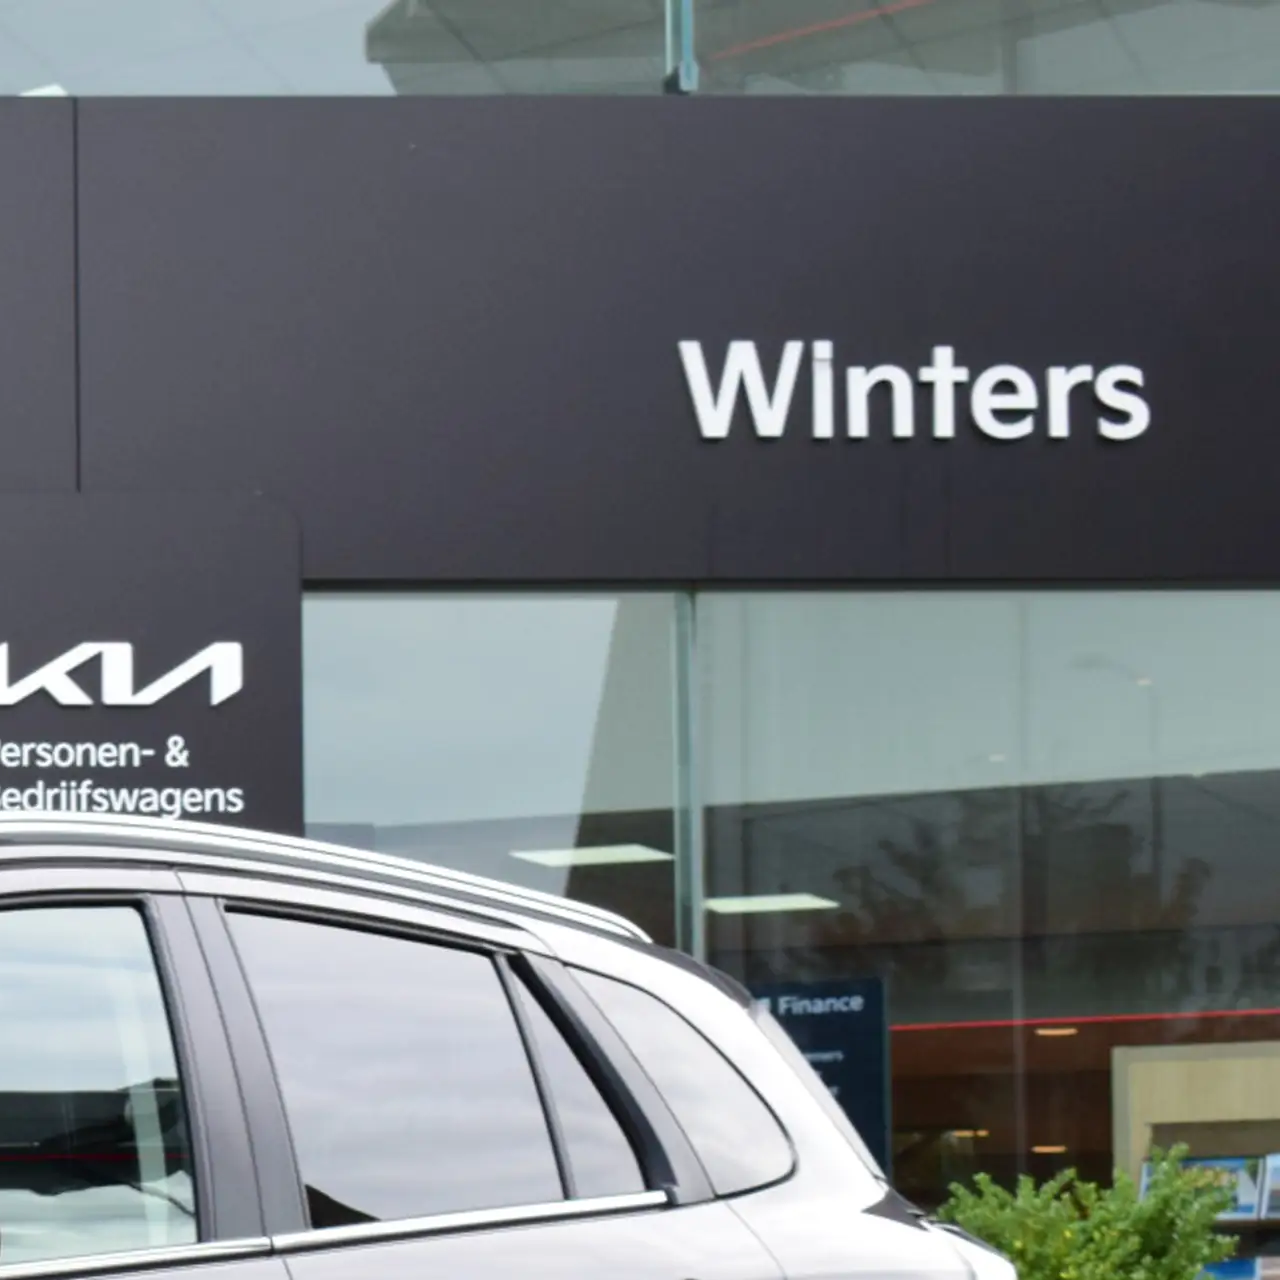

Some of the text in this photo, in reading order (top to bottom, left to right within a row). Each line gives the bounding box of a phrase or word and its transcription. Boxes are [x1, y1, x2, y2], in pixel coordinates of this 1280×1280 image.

[677, 340, 1151, 440] Winters
[164, 735, 190, 767] &
[777, 994, 864, 1016] Finance
